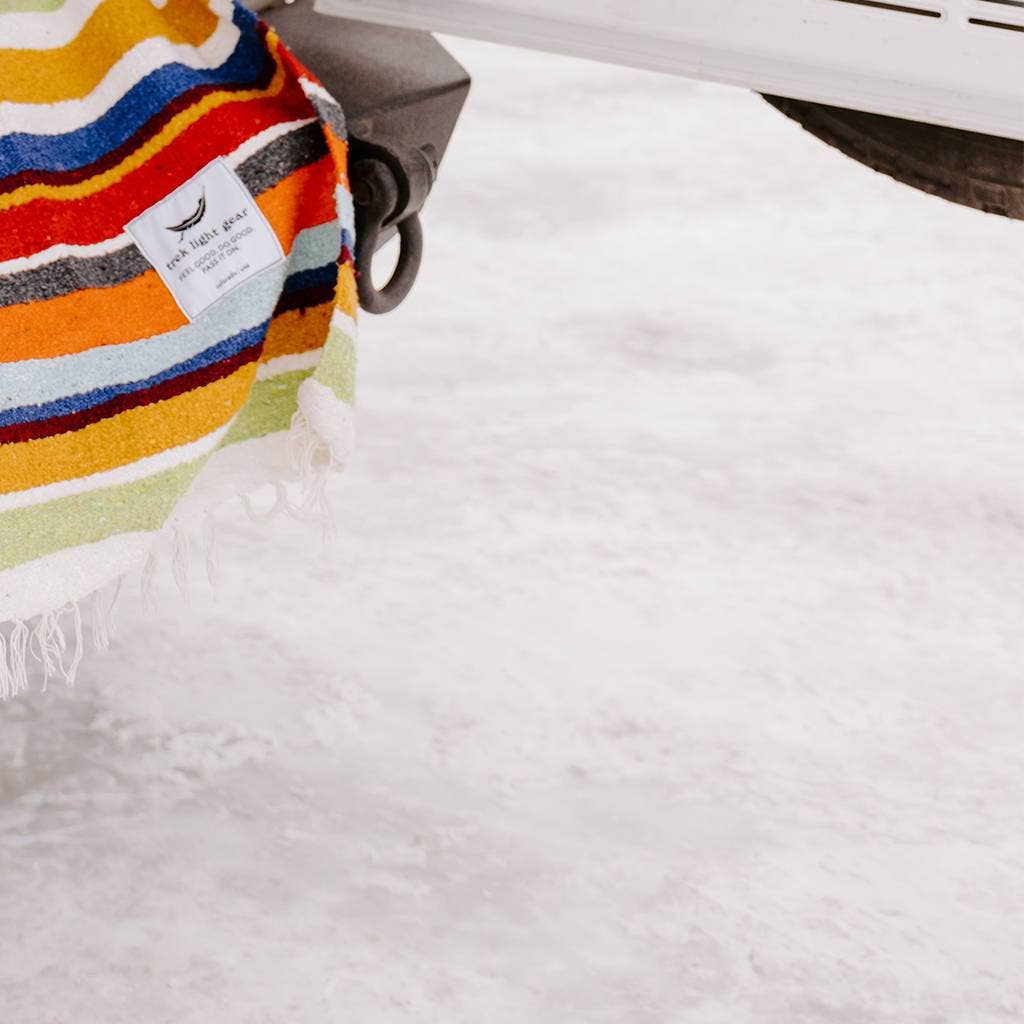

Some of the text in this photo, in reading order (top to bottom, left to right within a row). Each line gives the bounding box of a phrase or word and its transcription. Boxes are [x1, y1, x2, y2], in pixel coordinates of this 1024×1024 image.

[166, 208, 248, 271] trek light gear
[179, 266, 194, 281] FEEL
[218, 240, 231, 251] DO
[202, 258, 219, 273] PASS
